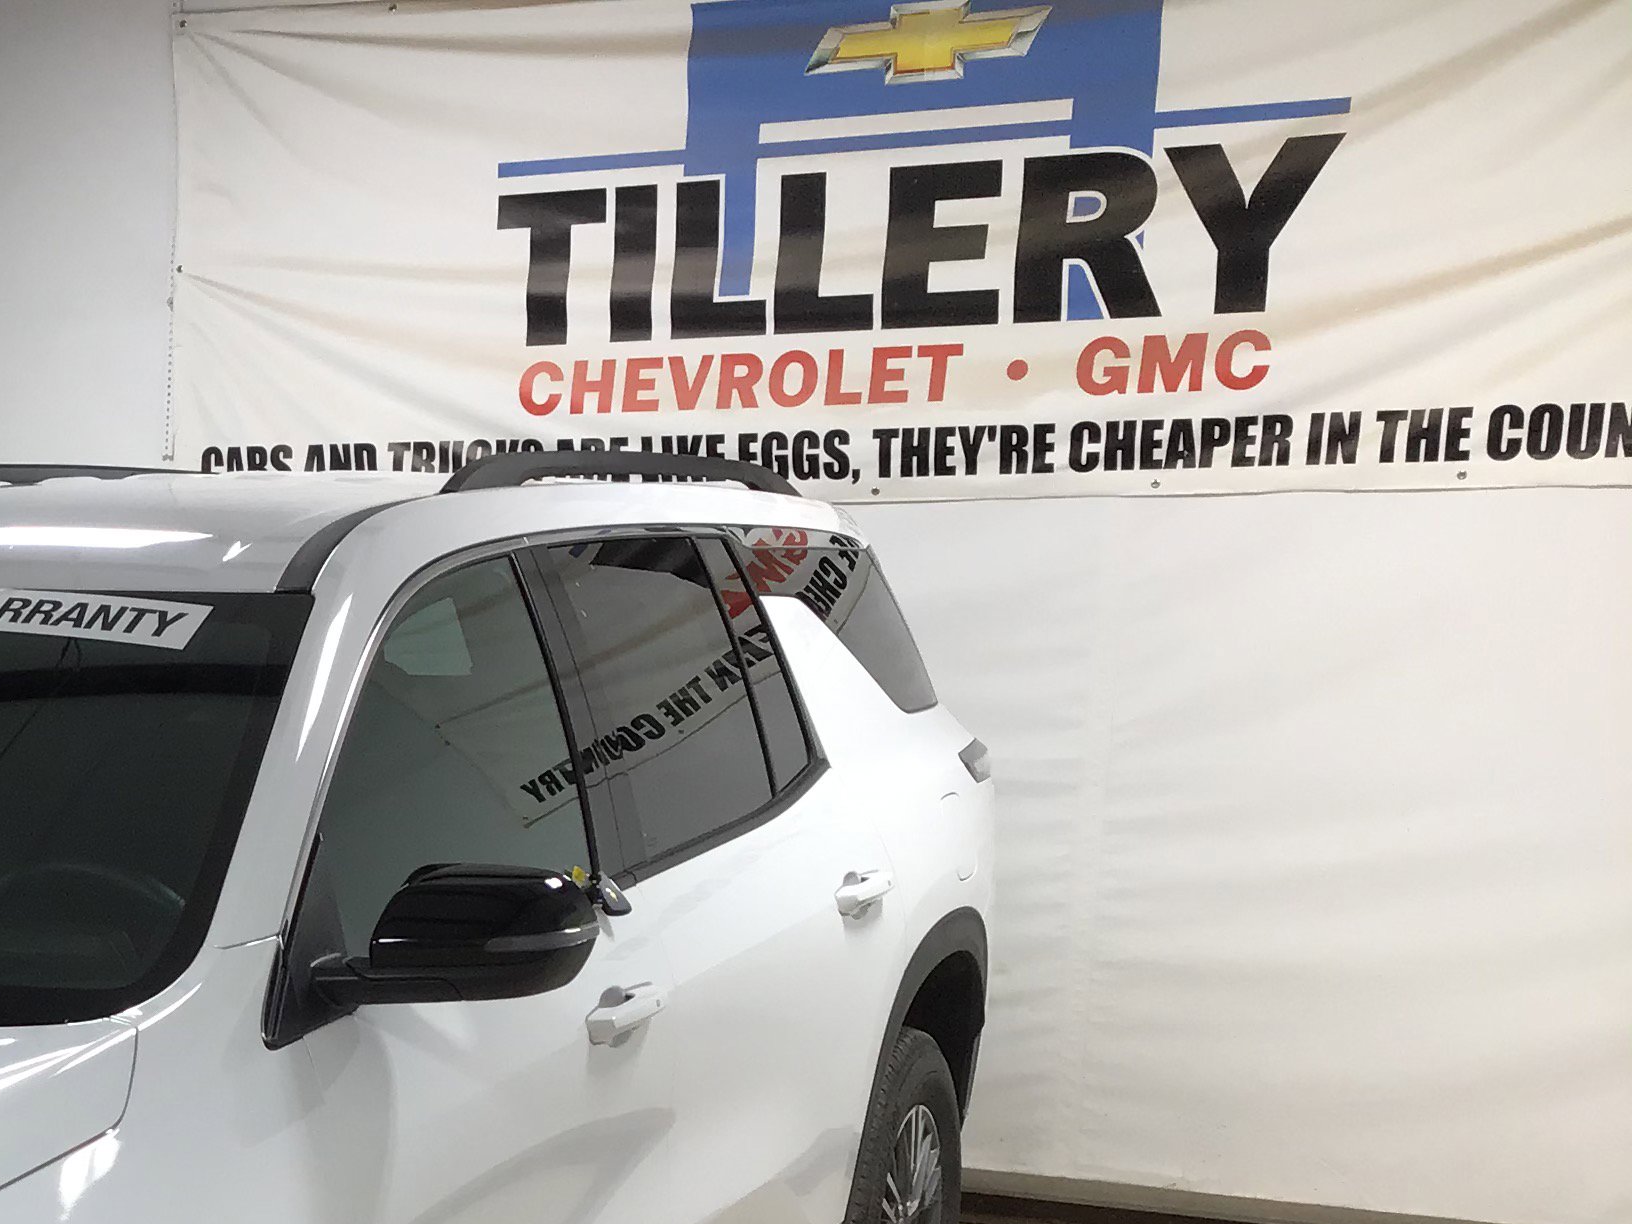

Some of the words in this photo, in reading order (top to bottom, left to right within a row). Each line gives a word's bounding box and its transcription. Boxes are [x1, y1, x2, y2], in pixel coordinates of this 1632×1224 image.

[497, 132, 1347, 347] TILLERY
[518, 344, 964, 417] CHEVROLET
[1075, 329, 1273, 396] GMC
[738, 431, 861, 484] EGGS,
[876, 423, 1057, 479] THEY'RE
[1067, 416, 1294, 473] CHEAPER
[1305, 412, 1365, 467] IN
[1375, 405, 1474, 464] THE
